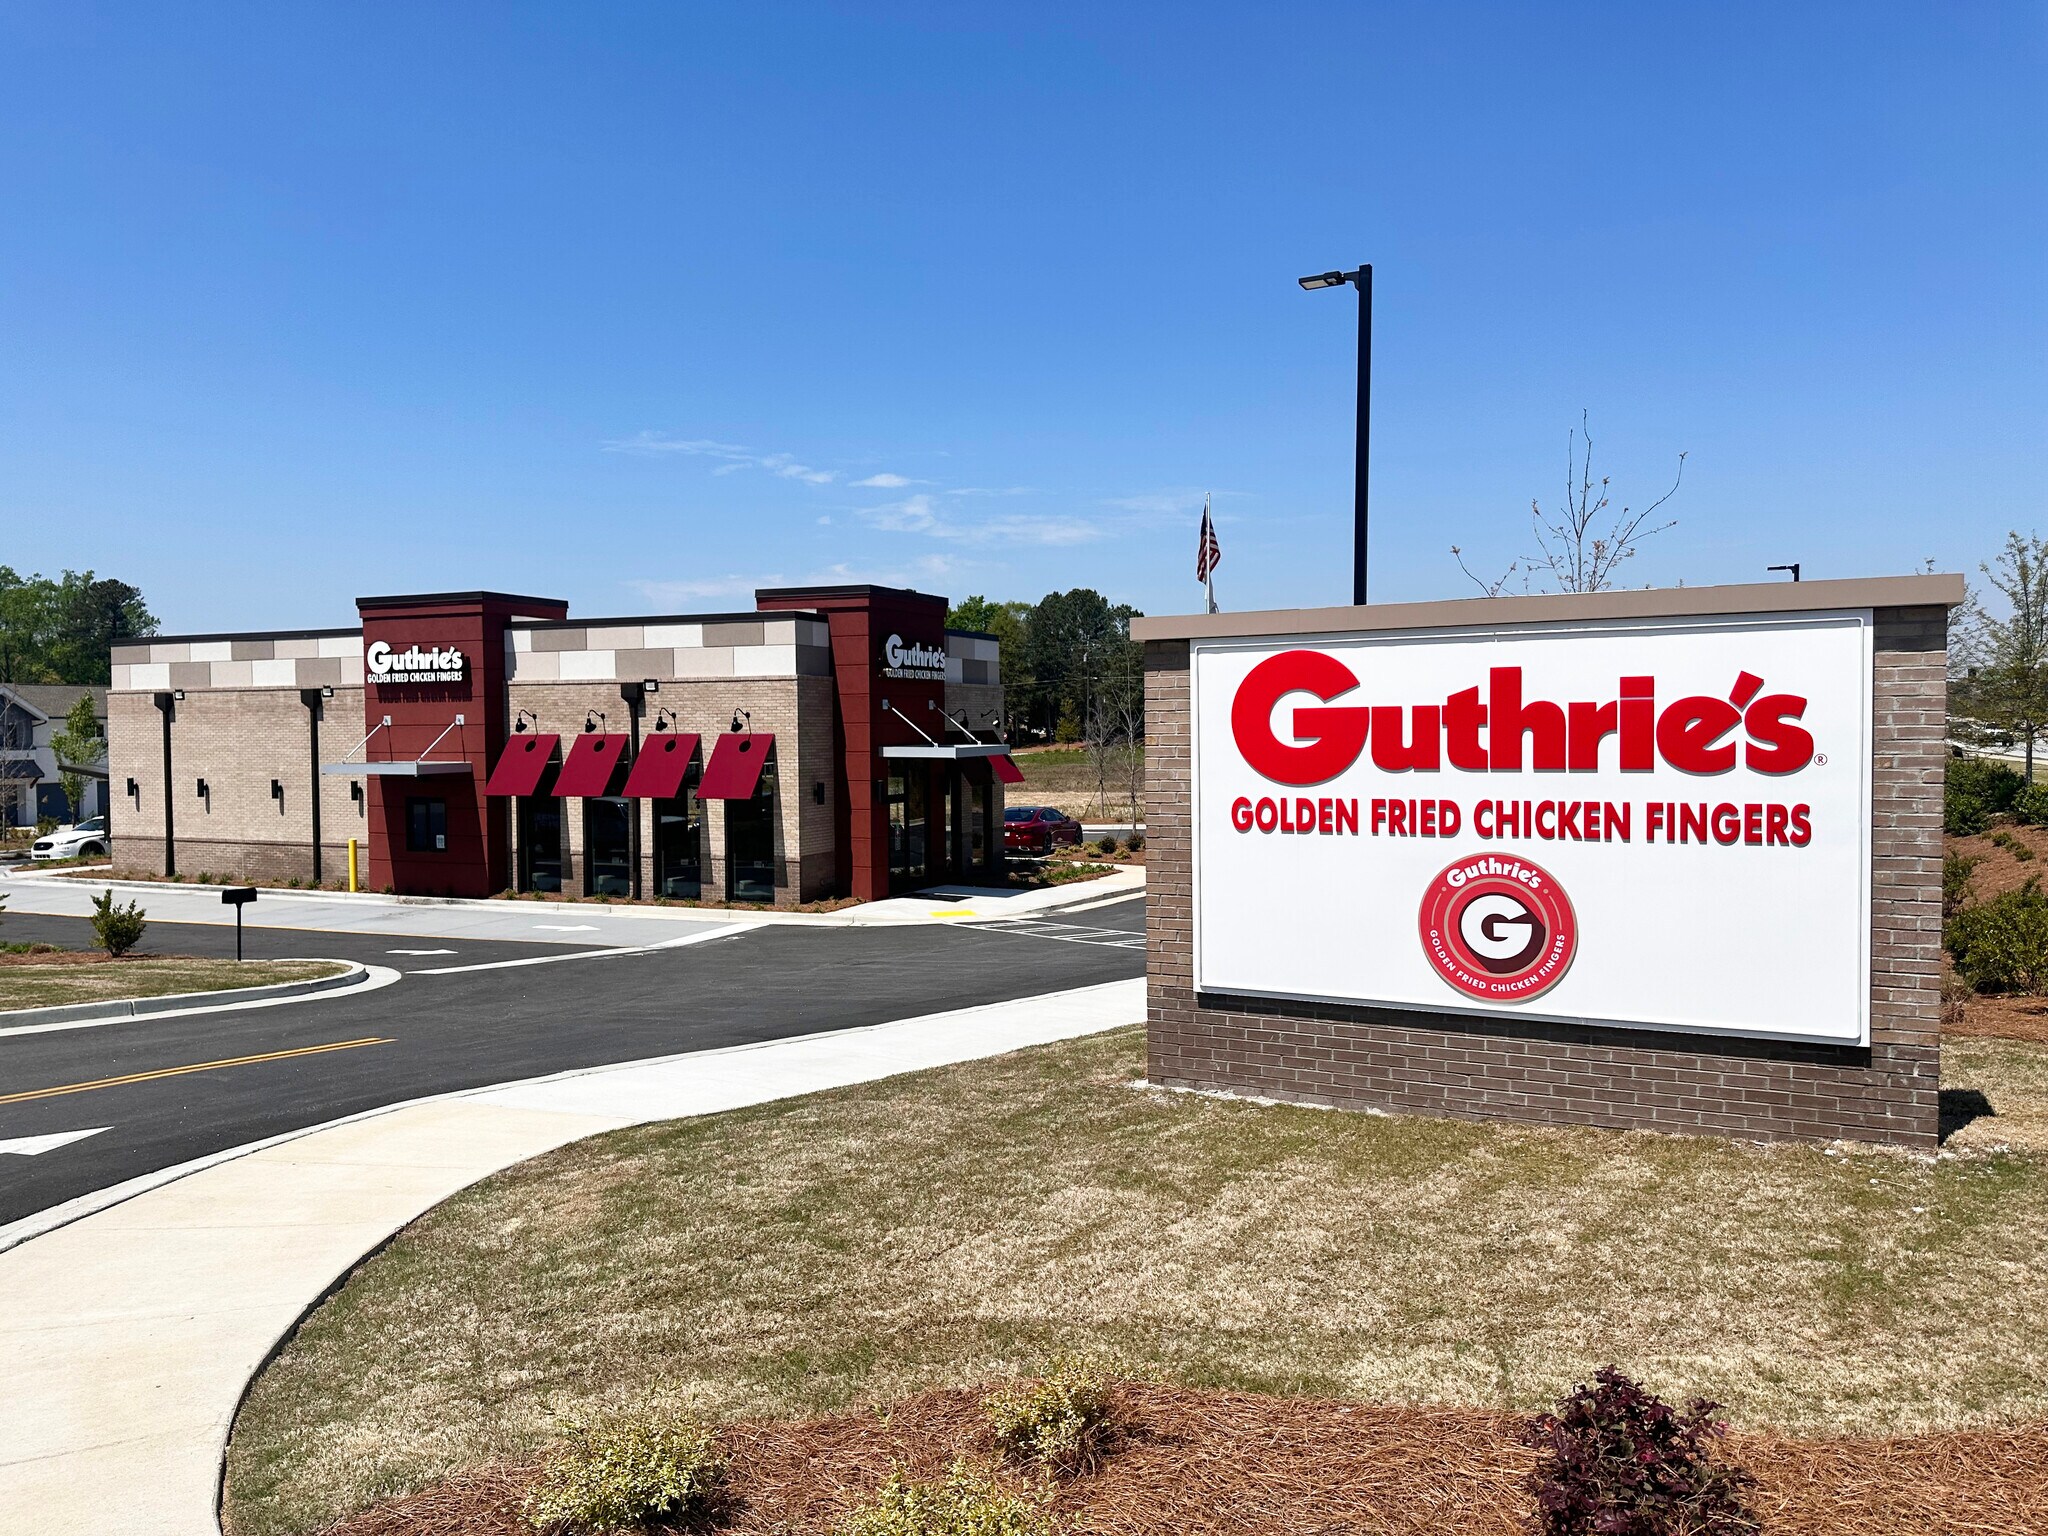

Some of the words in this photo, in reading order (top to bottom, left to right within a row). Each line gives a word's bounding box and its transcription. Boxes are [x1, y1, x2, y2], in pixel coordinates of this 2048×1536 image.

[367, 641, 463, 674] Guthrie's
[886, 633, 946, 669] Guthrie's
[367, 673, 391, 683] GOLDEN
[391, 672, 408, 683] FRIED
[409, 671, 436, 683] CHICKEN
[436, 671, 463, 682] FINGERS
[887, 668, 904, 678] GOLDEN
[1231, 796, 1359, 836] GOLDEN
[1371, 798, 1461, 838] FRIED
[1474, 800, 1631, 842] CHICKEN
[1646, 803, 1812, 847] FINGERS
[1446, 857, 1542, 889] Guthrie's
[1430, 929, 1456, 972] GOLDEN
[1456, 971, 1487, 990] FRIED
[1490, 974, 1539, 993] CHICKEN
[1538, 934, 1566, 977] FINGERS
